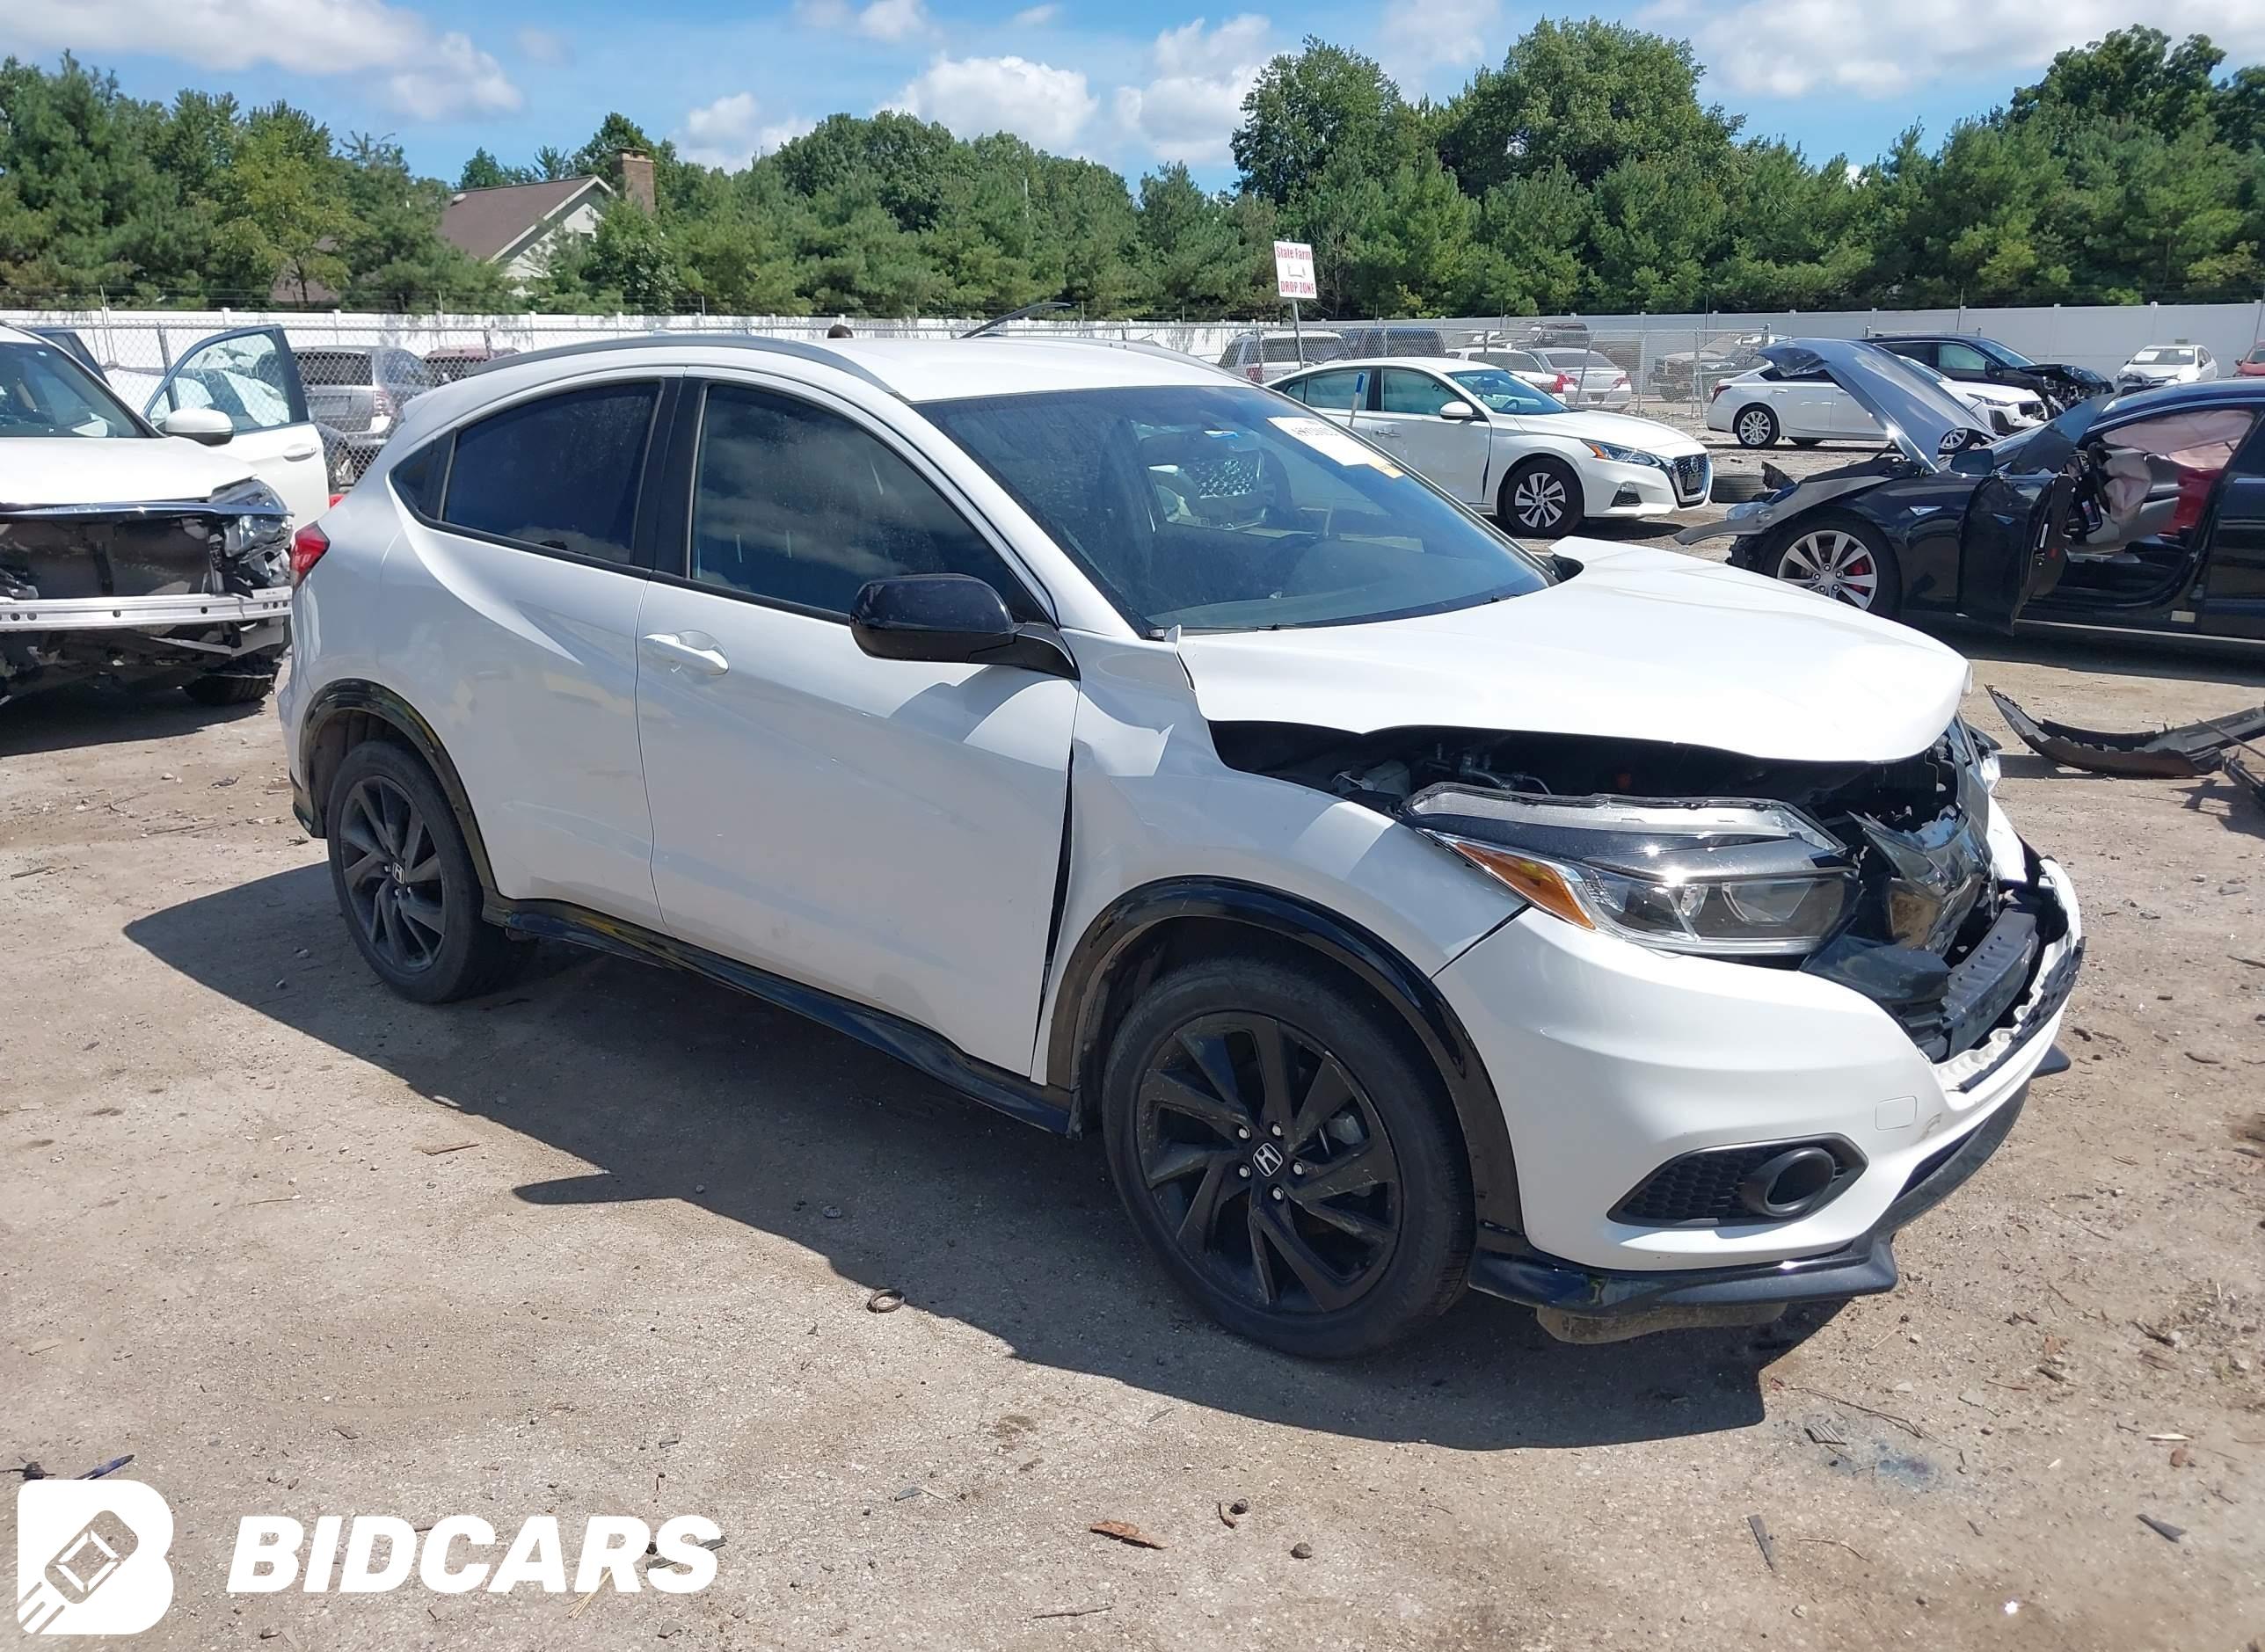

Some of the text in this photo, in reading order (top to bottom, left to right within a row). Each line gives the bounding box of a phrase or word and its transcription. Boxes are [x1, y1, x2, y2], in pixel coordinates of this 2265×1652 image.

[1276, 246, 1312, 260] State Farm
[1280, 281, 1315, 294] DROP ZONE
